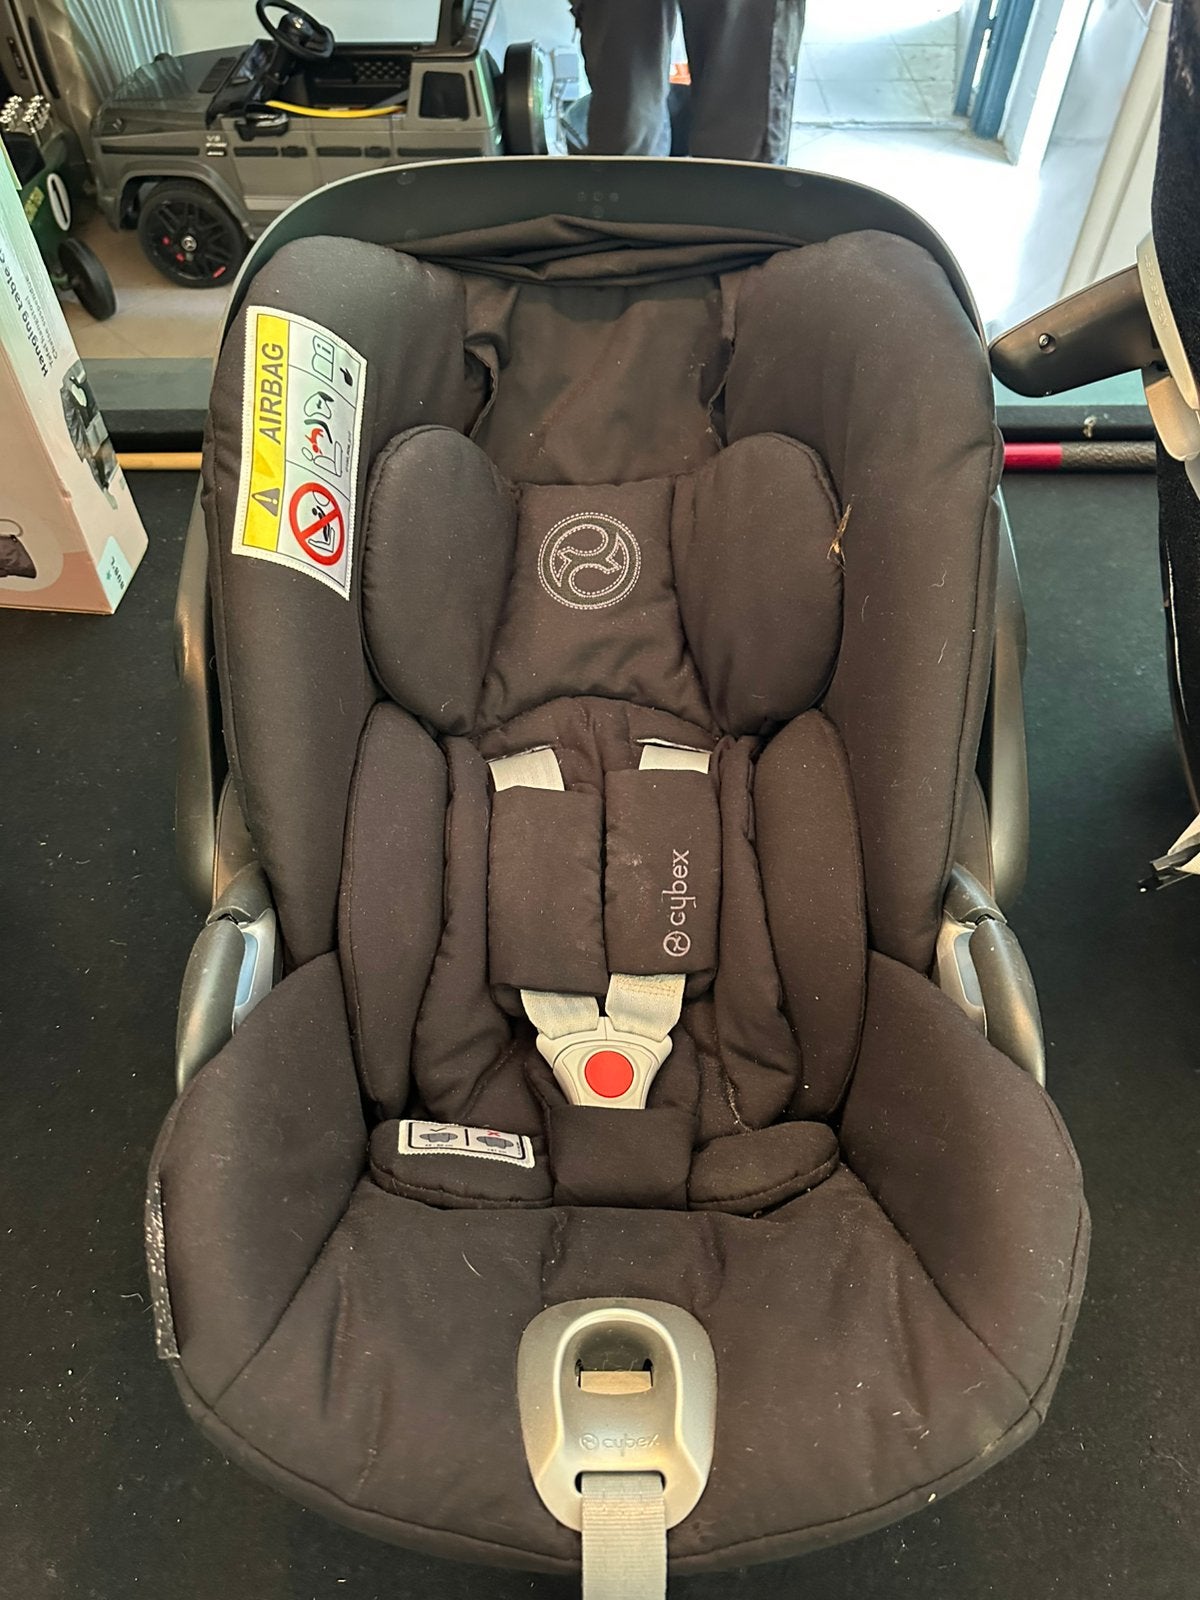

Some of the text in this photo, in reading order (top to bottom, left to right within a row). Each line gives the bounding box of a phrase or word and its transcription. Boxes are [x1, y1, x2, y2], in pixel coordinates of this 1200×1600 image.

[4, 266, 23, 311] table
[22, 310, 49, 377] Hanging
[259, 342, 284, 445] AIRBAG
[661, 848, 696, 926] cybex
[602, 1432, 660, 1457] cybex
